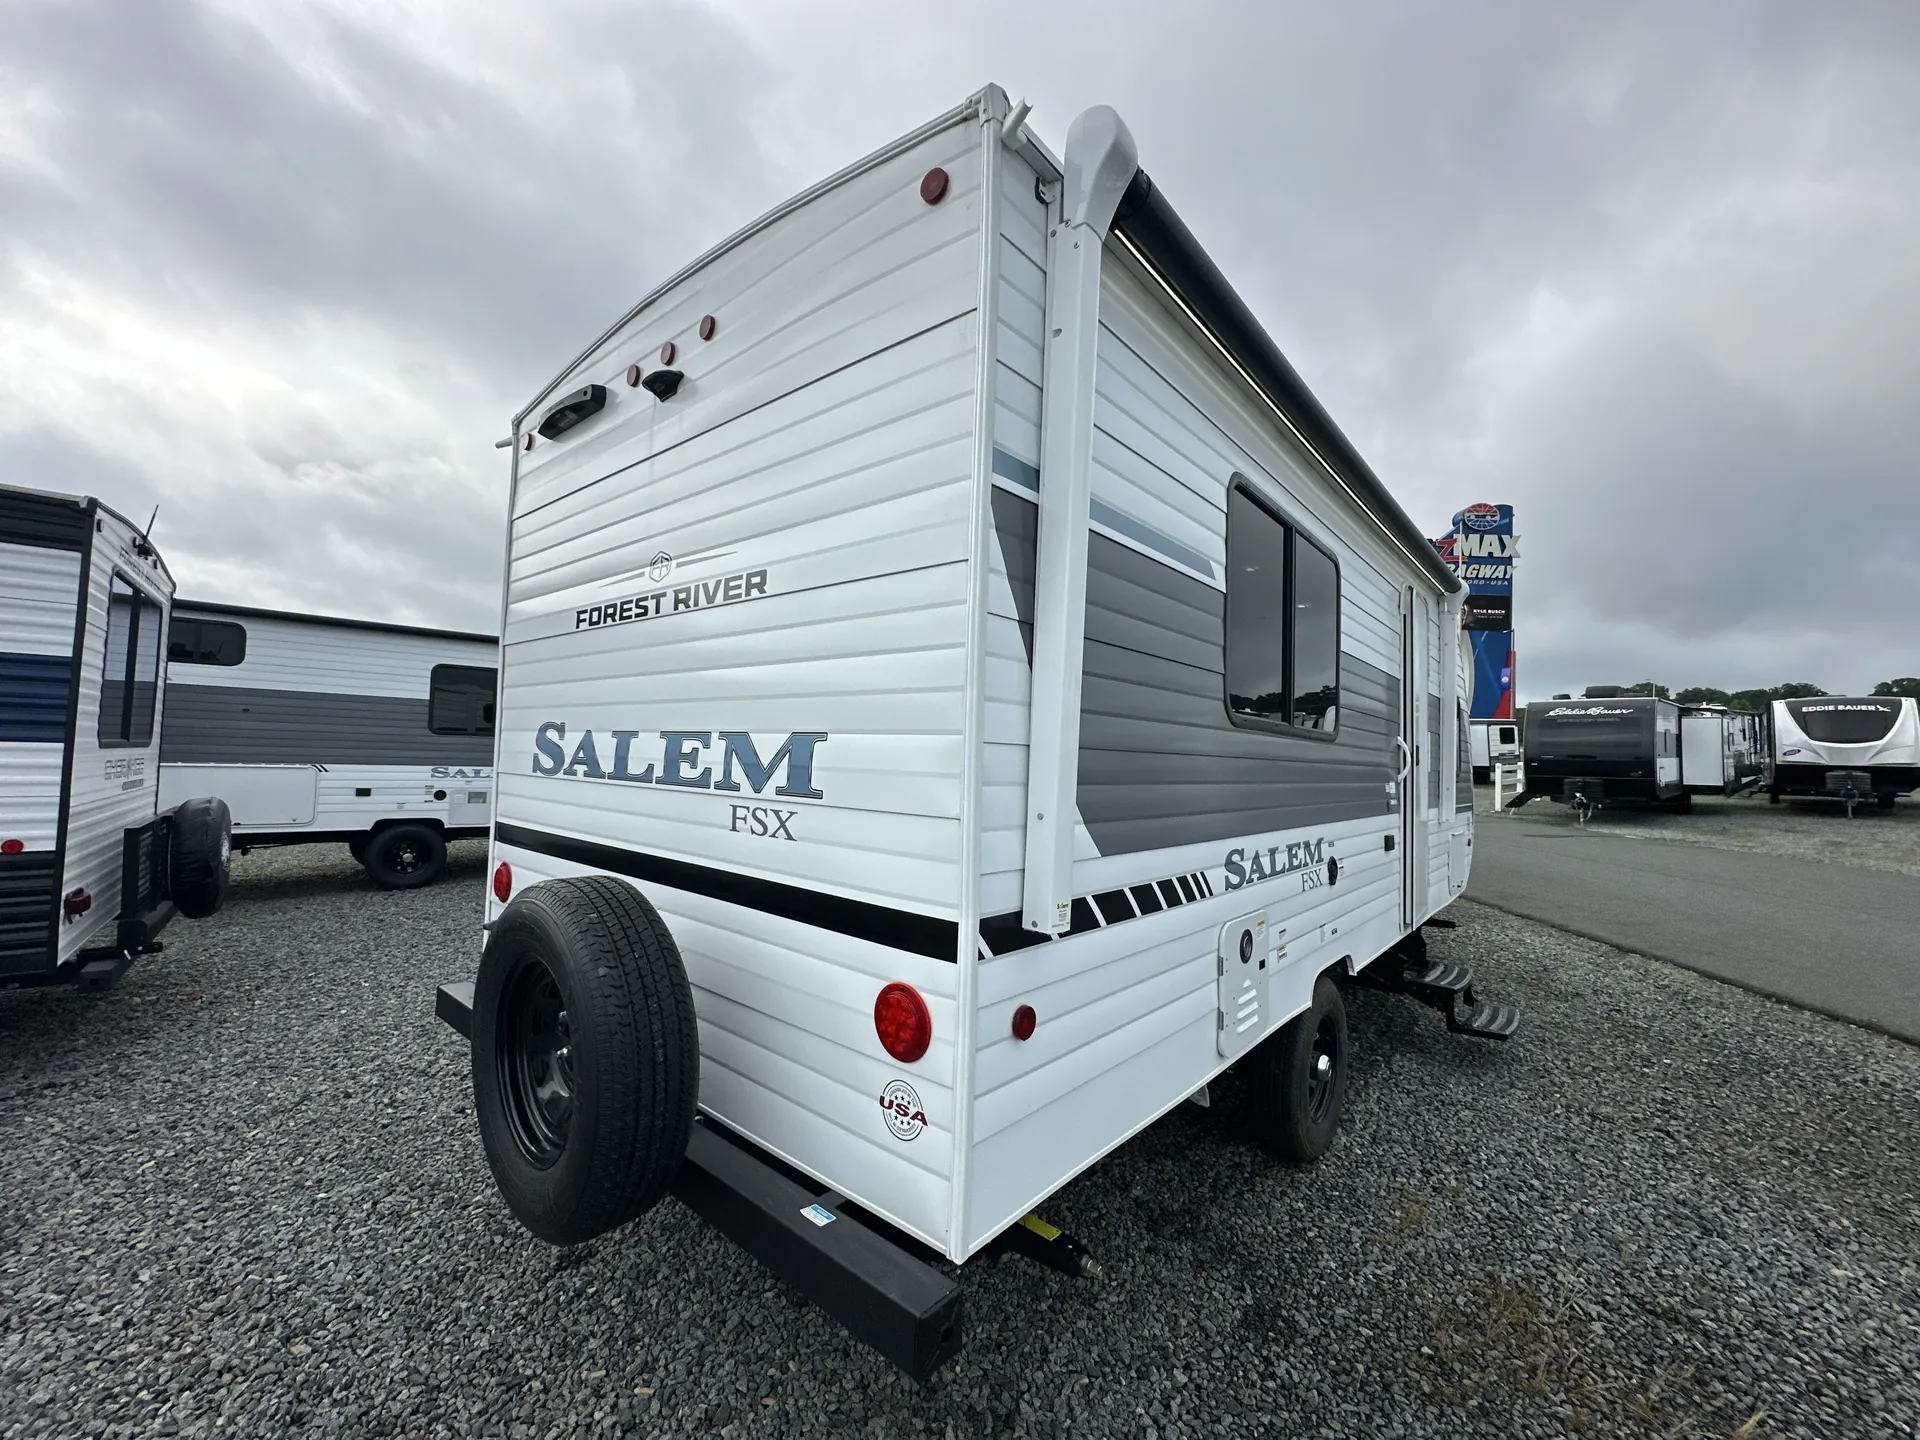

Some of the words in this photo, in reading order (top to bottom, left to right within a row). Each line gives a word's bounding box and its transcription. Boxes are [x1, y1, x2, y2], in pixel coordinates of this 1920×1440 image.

[575, 591, 668, 630] FOREST
[673, 569, 769, 613] RIVER
[1544, 707, 1588, 717] Eddie
[1586, 706, 1634, 716] Bauer
[430, 767, 494, 779] SAL
[532, 721, 829, 800] SALEM
[729, 804, 798, 842] FSX
[1223, 837, 1325, 892] SALEM
[1300, 867, 1323, 893] FSX
[878, 1095, 928, 1127] USA
